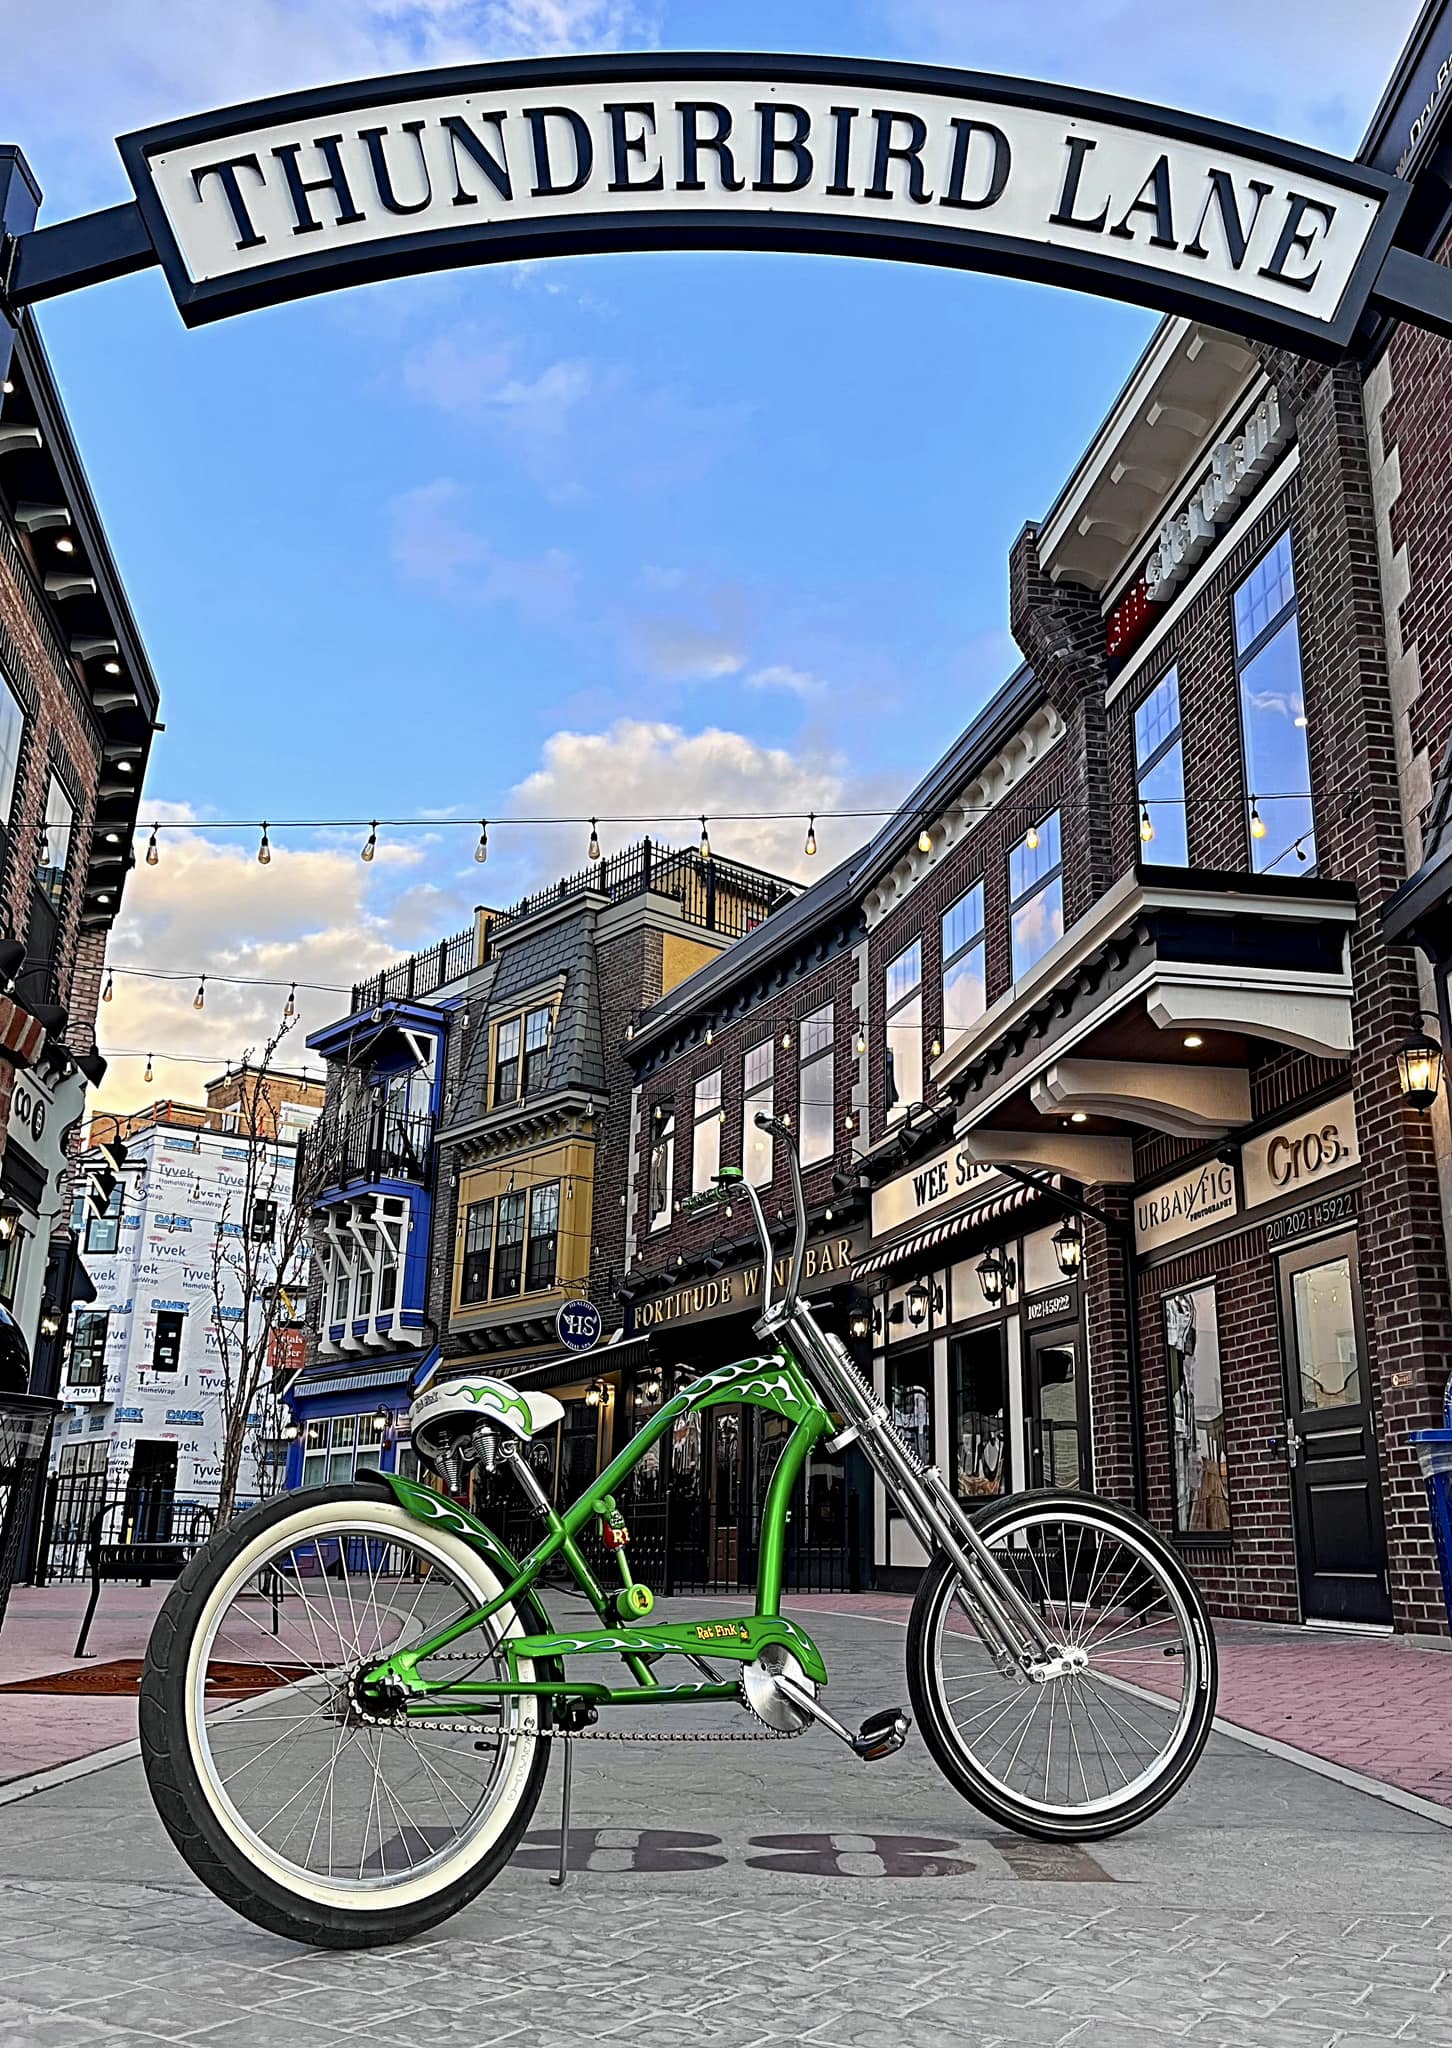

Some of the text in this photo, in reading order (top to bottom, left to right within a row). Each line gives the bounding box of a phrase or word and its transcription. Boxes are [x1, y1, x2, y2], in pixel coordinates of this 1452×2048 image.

[191, 101, 1337, 292] THUNDERBIRD LANE
[1267, 1125, 1348, 1186] Cros.
[159, 1163, 195, 1178] Tyvek
[217, 1172, 245, 1187] Tyve
[912, 1161, 948, 1206] WEE
[149, 1242, 187, 1256] Tyvek
[90, 1270, 115, 1281] yvek
[633, 1276, 732, 1330] FORTITUDE
[805, 1239, 852, 1278] BAR
[204, 1334, 239, 1347] Tyek
[138, 1387, 176, 1395] HomeWrap
[193, 1463, 221, 1478] Tyve
[696, 1625, 713, 1640] Rat
